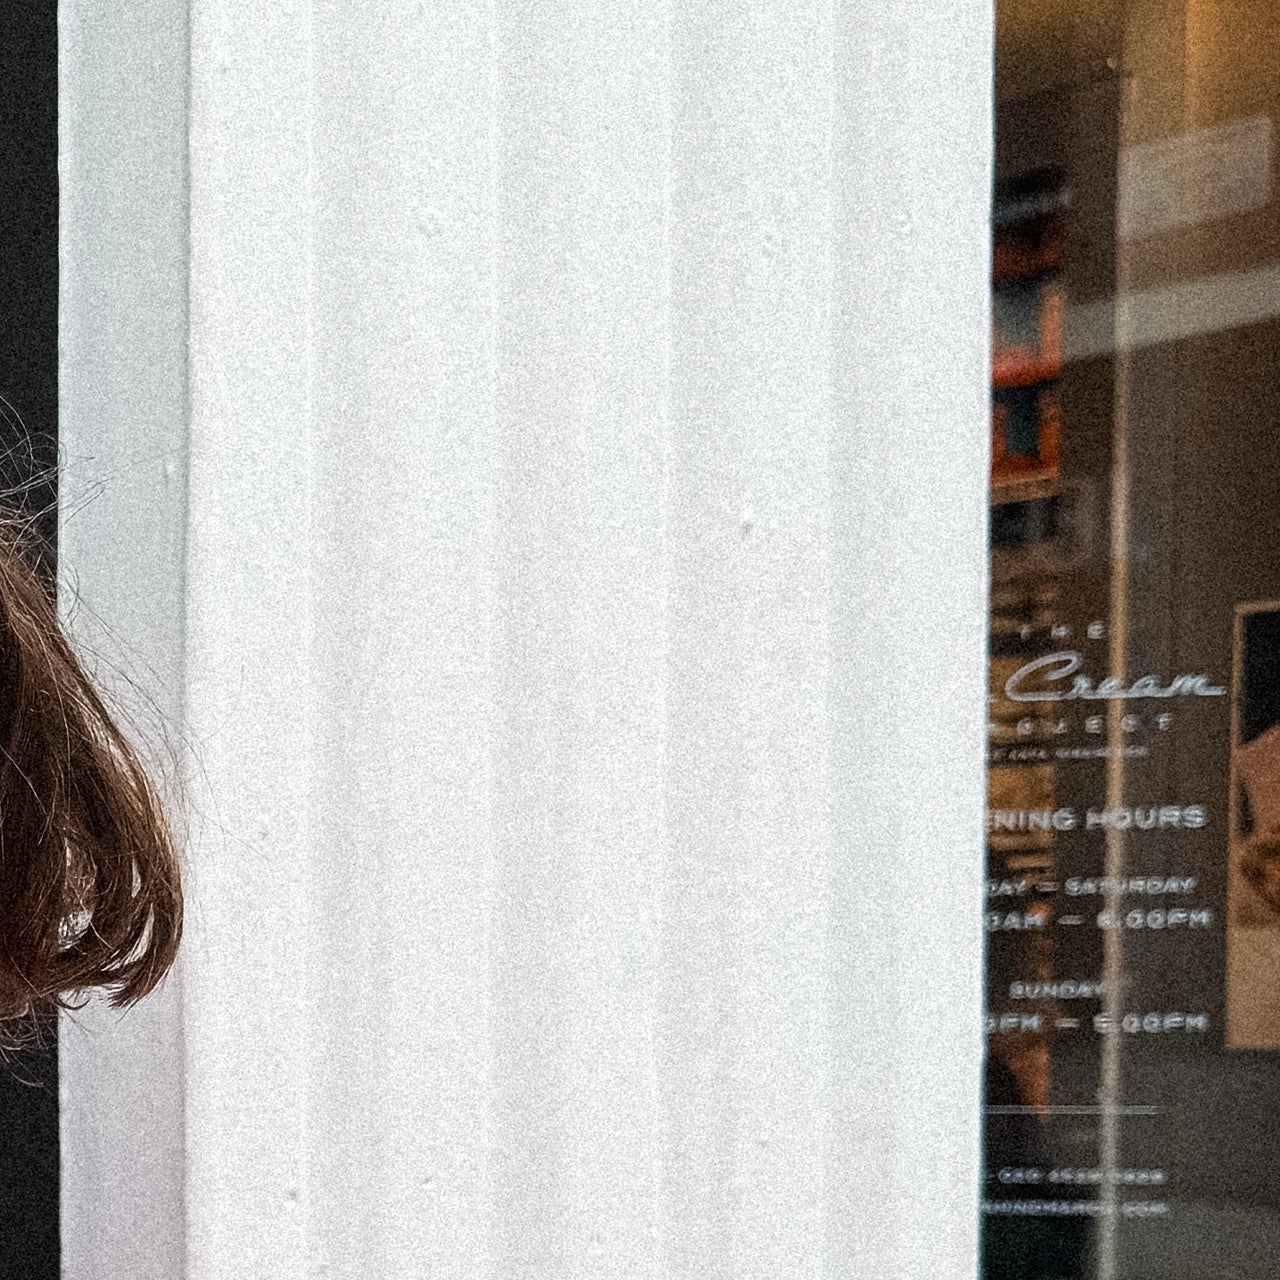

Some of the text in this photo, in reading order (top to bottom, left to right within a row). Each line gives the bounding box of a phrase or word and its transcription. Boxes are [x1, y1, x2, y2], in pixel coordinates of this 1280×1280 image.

[1004, 650, 1227, 702] Cream
[1085, 805, 1208, 830] HOURS
[1064, 876, 1198, 896] SATURDAY
